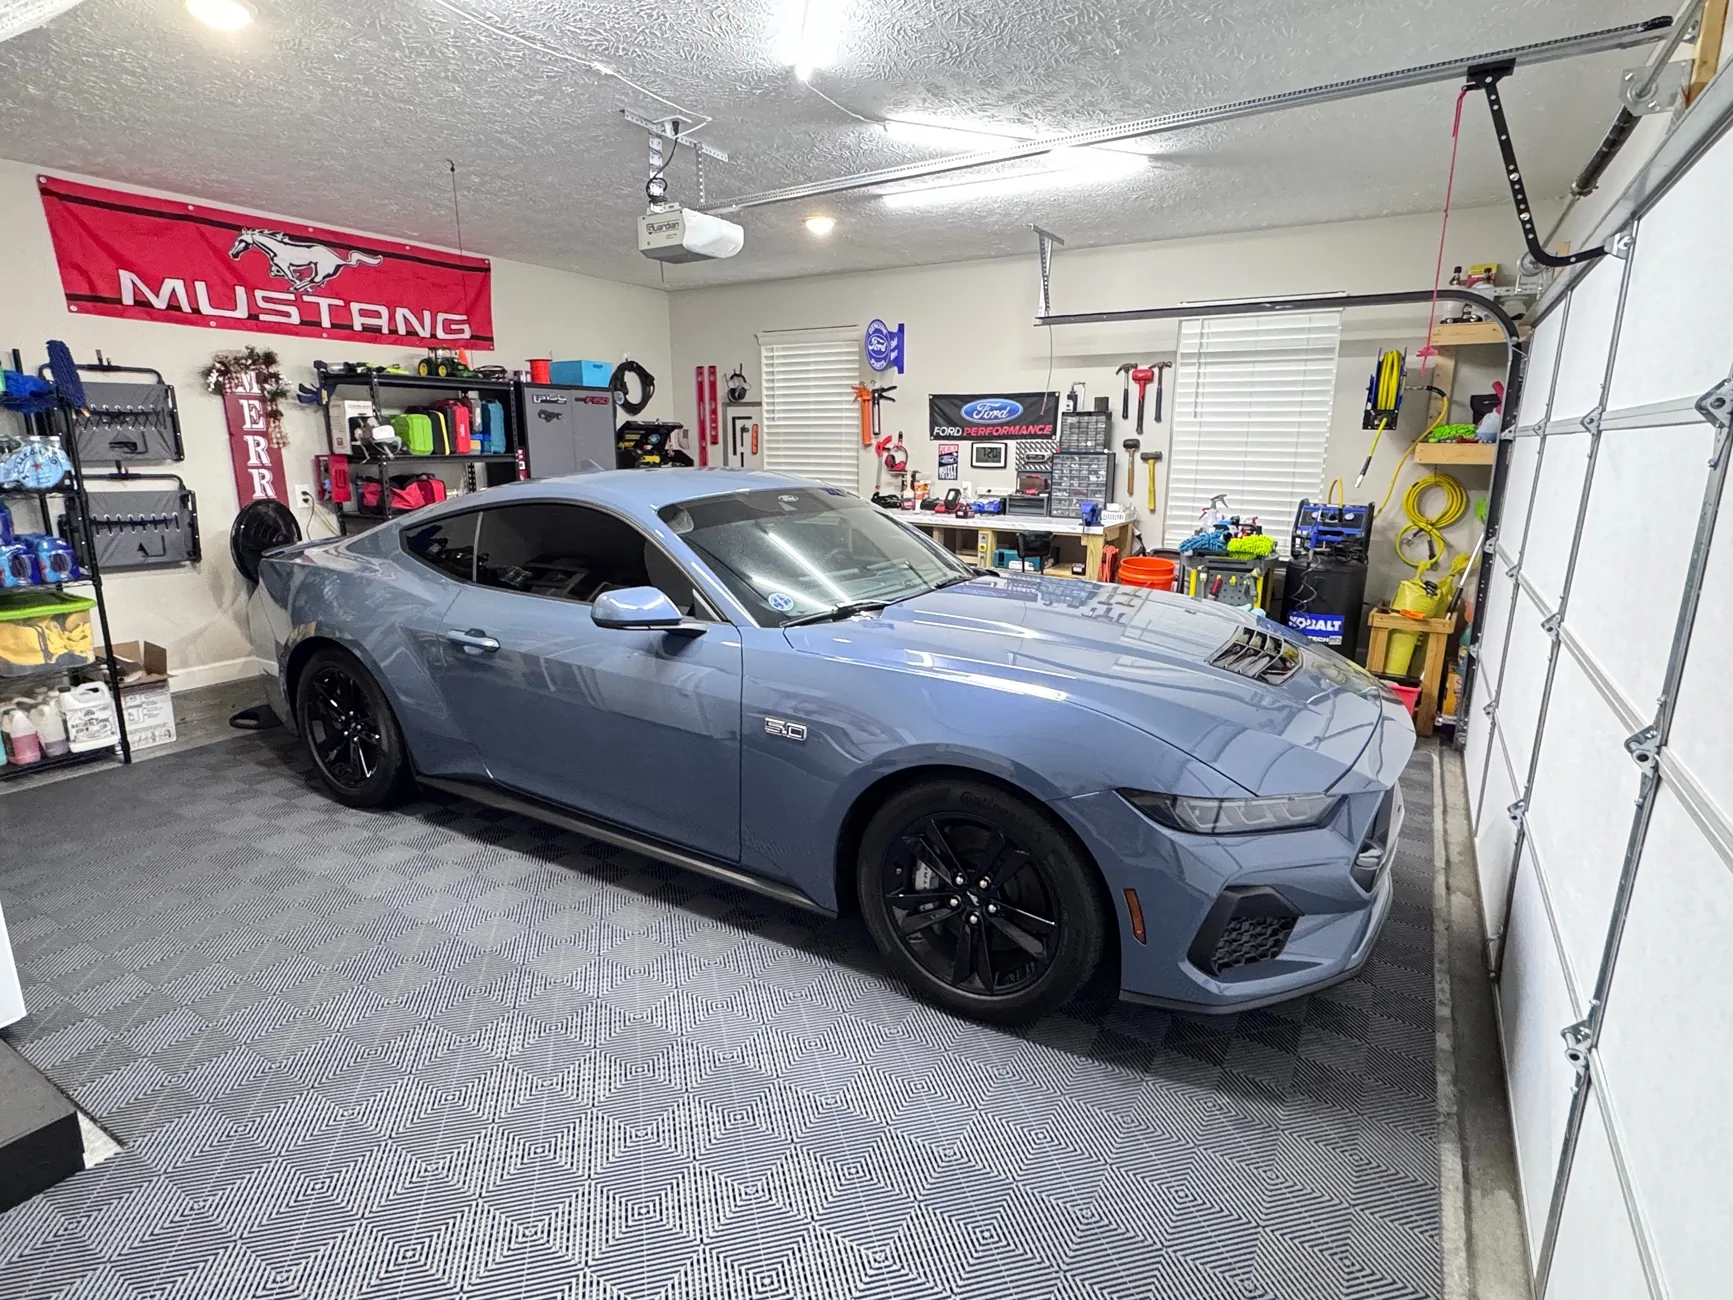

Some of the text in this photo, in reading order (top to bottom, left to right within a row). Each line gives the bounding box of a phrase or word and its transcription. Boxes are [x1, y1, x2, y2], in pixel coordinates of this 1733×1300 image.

[646, 221, 680, 234] Guardian
[117, 268, 473, 341] MUSTANG
[868, 336, 888, 352] Ford
[973, 402, 1009, 419] Ford
[933, 424, 1053, 437] FORD PERFORMANCE
[1288, 615, 1342, 631] KOBALT
[764, 717, 807, 741] 5.0
